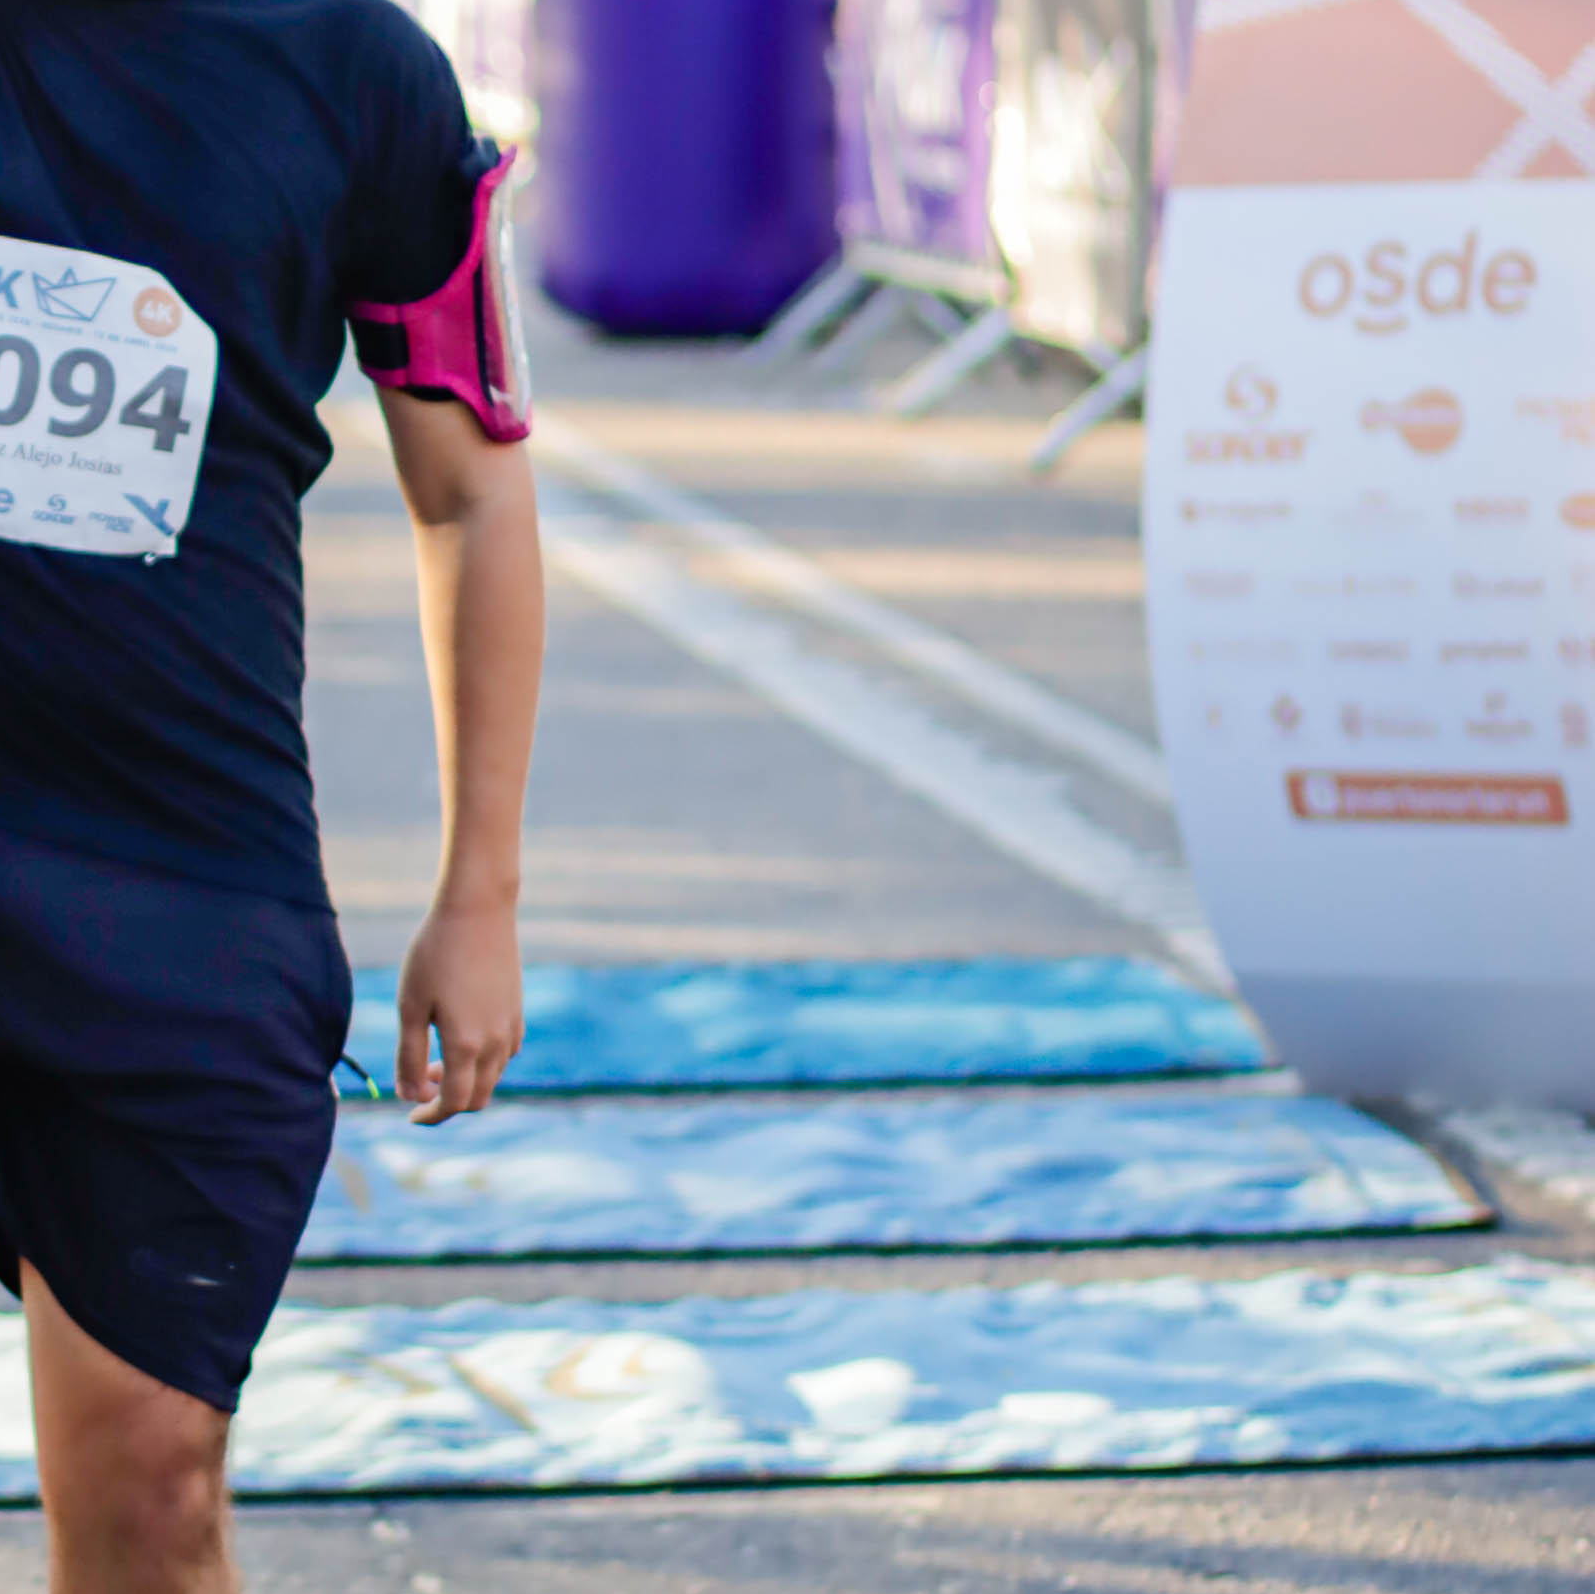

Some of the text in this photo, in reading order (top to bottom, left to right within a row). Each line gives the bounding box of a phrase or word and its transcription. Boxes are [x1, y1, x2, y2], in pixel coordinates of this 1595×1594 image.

[1298, 226, 1538, 335] osde
[10, 441, 63, 468] Alejo
[68, 451, 123, 476] Josias
